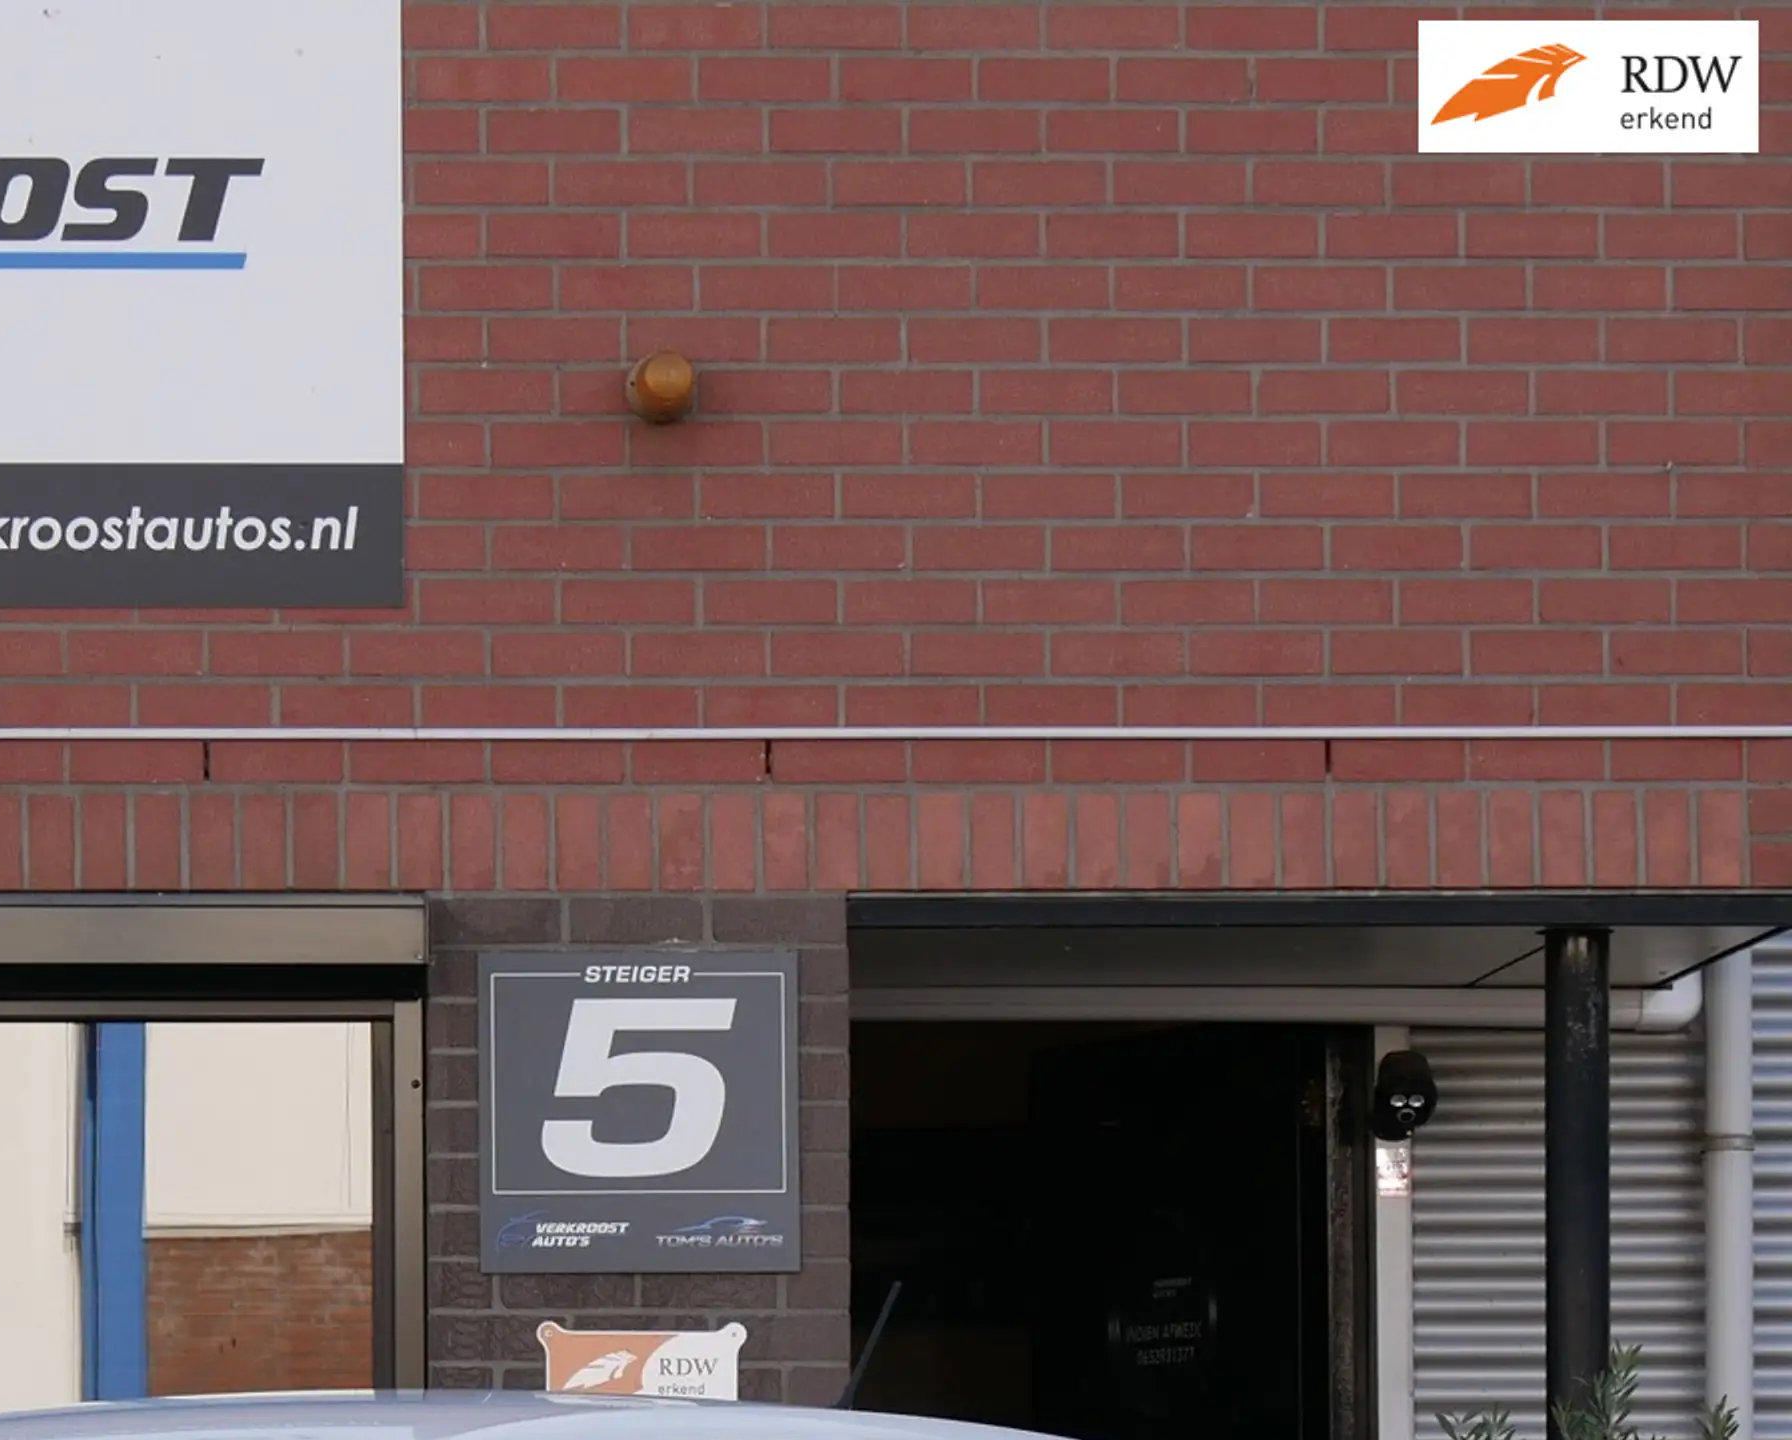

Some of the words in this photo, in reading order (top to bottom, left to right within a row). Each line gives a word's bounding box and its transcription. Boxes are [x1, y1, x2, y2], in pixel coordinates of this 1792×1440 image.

[584, 965, 692, 984] STEIGER
[541, 997, 738, 1178] 5
[535, 1222, 630, 1235] VERKROOST
[531, 1235, 590, 1248] AUTO'S
[658, 1357, 719, 1376] RDW
[658, 1382, 706, 1396] erkend
